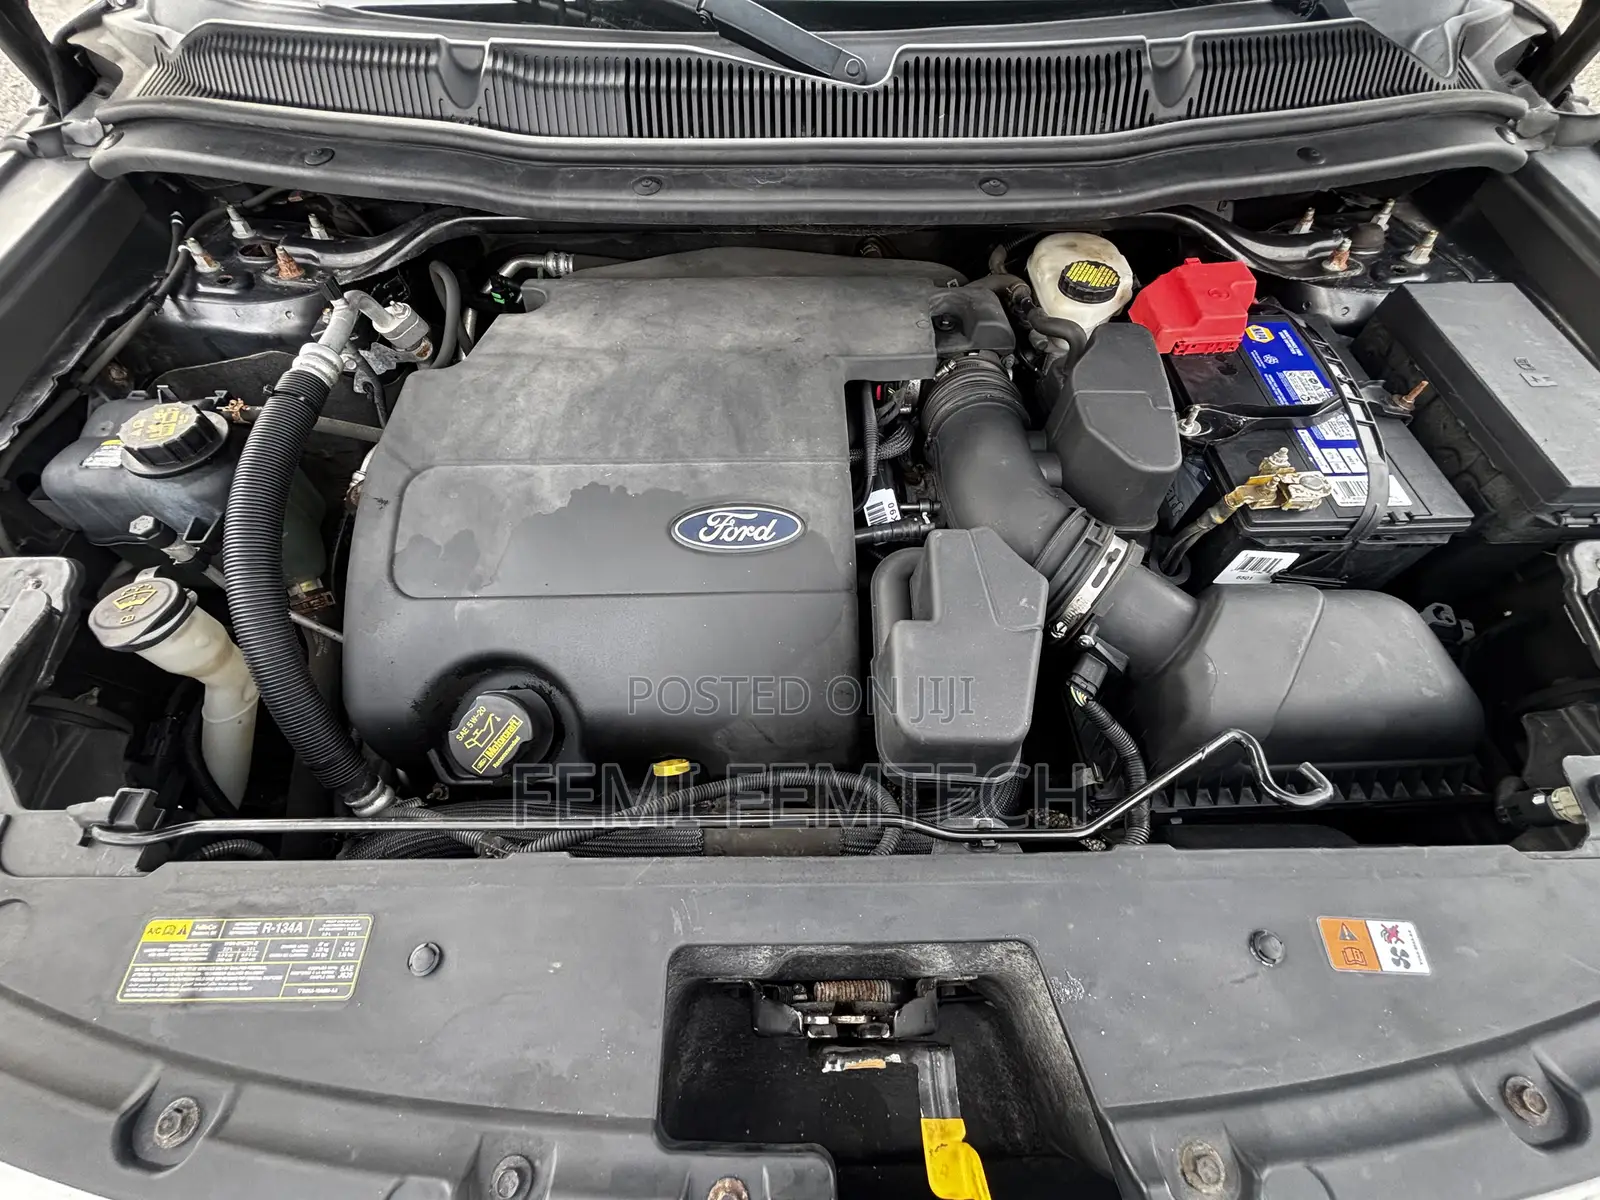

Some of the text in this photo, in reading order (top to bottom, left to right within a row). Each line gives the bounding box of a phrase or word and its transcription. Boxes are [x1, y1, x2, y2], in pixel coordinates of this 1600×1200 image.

[698, 512, 778, 542] Ford
[455, 705, 487, 742] SAE 5W-20
[486, 719, 520, 758] Motorcraft
[492, 735, 521, 768] Recommended
[147, 927, 162, 935] A/C
[262, 922, 303, 934] R-134A
